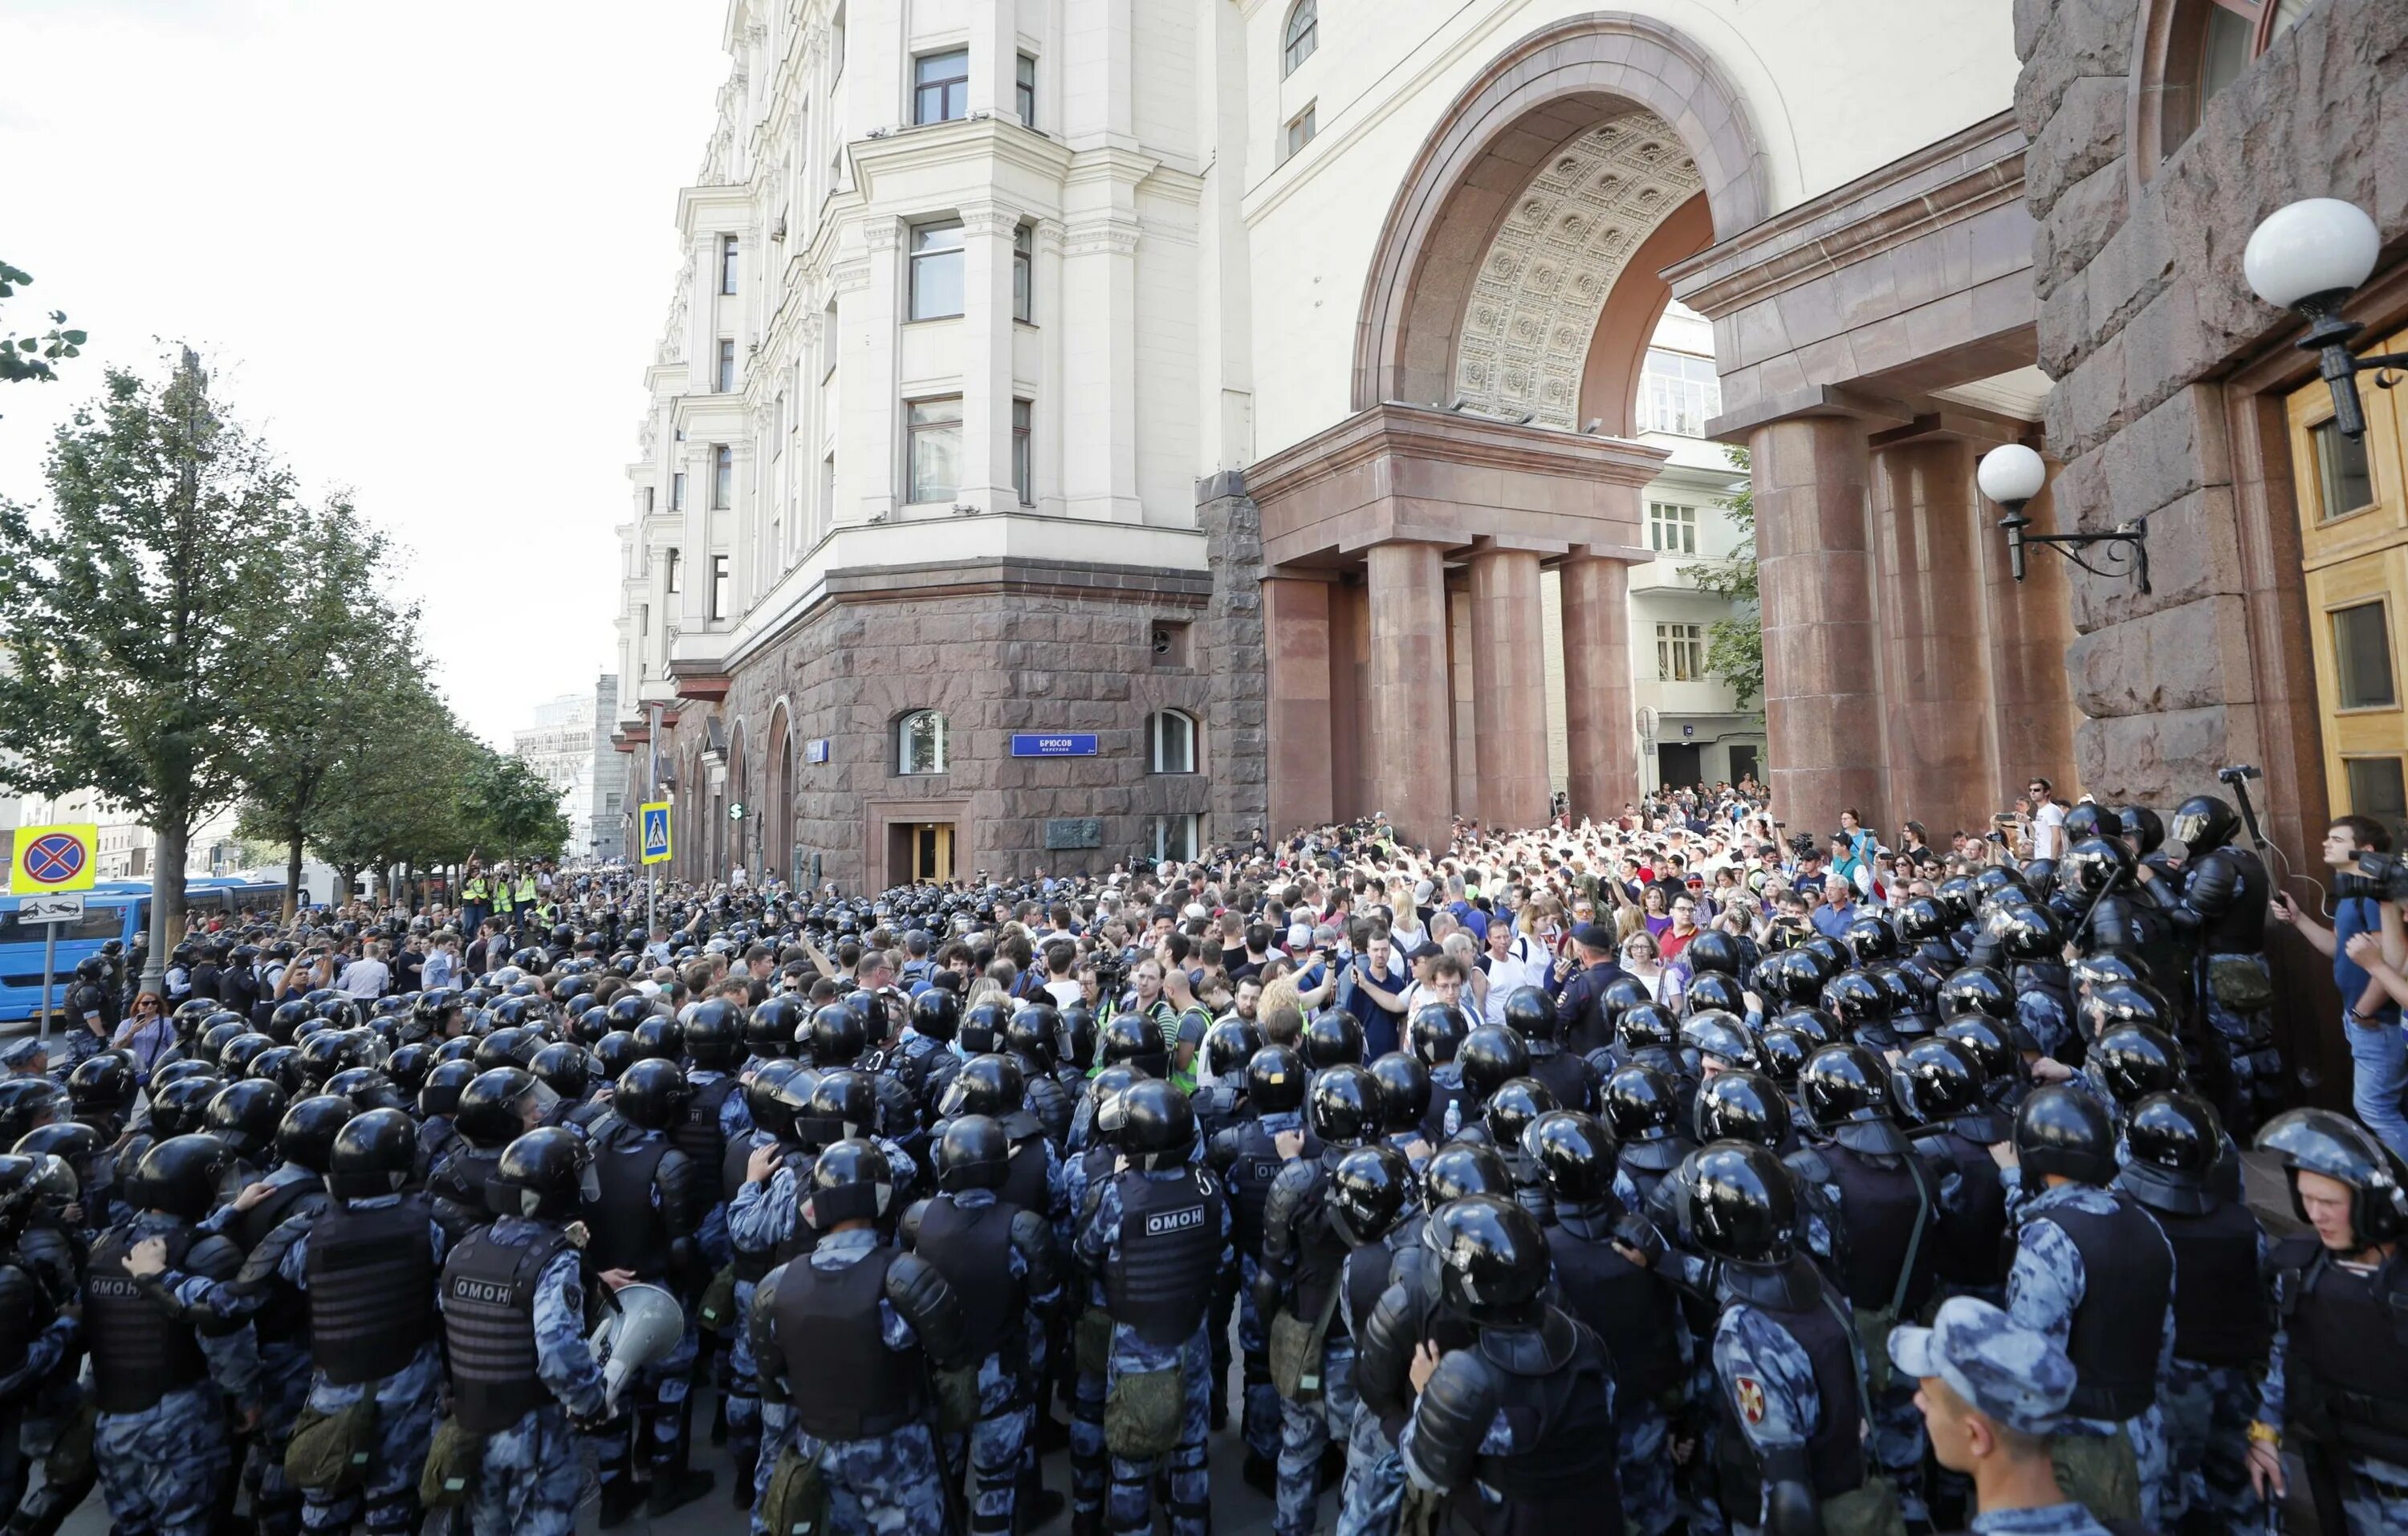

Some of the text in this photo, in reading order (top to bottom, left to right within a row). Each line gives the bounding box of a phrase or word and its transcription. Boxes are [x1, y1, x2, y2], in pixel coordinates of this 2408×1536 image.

[1039, 739, 1072, 747] БРЮСОВ
[730, 803, 742, 820] $
[1258, 1165, 1282, 1177] ОМ
[1149, 1209, 1202, 1231] ОМОН
[457, 1280, 509, 1303] ОМОН
